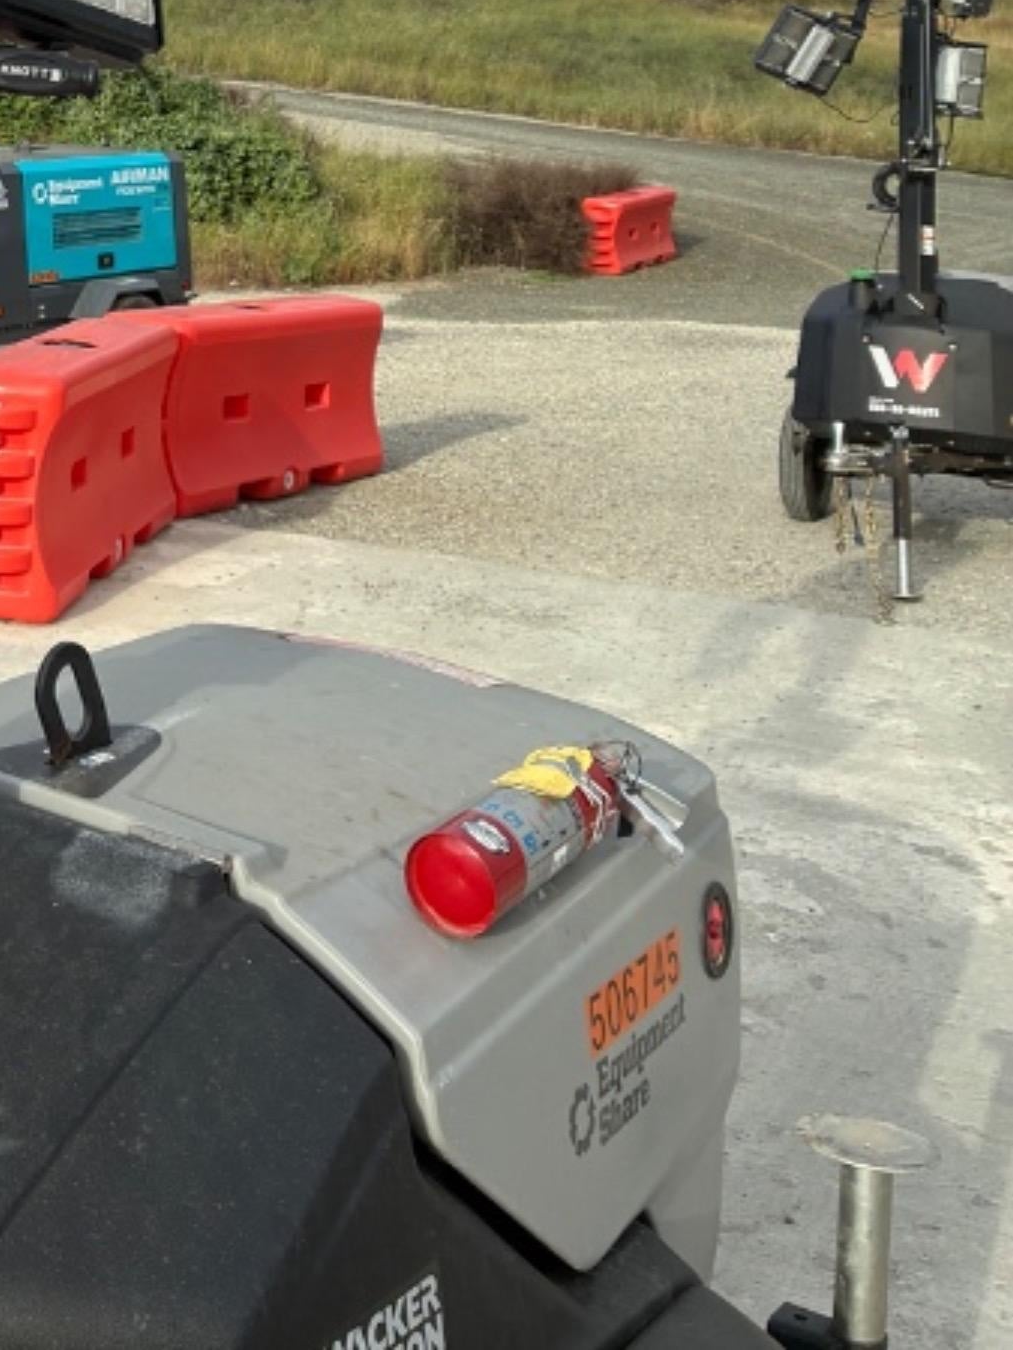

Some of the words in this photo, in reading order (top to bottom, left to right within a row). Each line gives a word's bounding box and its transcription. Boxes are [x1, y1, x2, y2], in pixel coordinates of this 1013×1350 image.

[588, 930, 680, 1050] 506745
[595, 992, 687, 1099] Equipment
[598, 1078, 652, 1147] Share
[323, 1273, 442, 1350] ACKER
